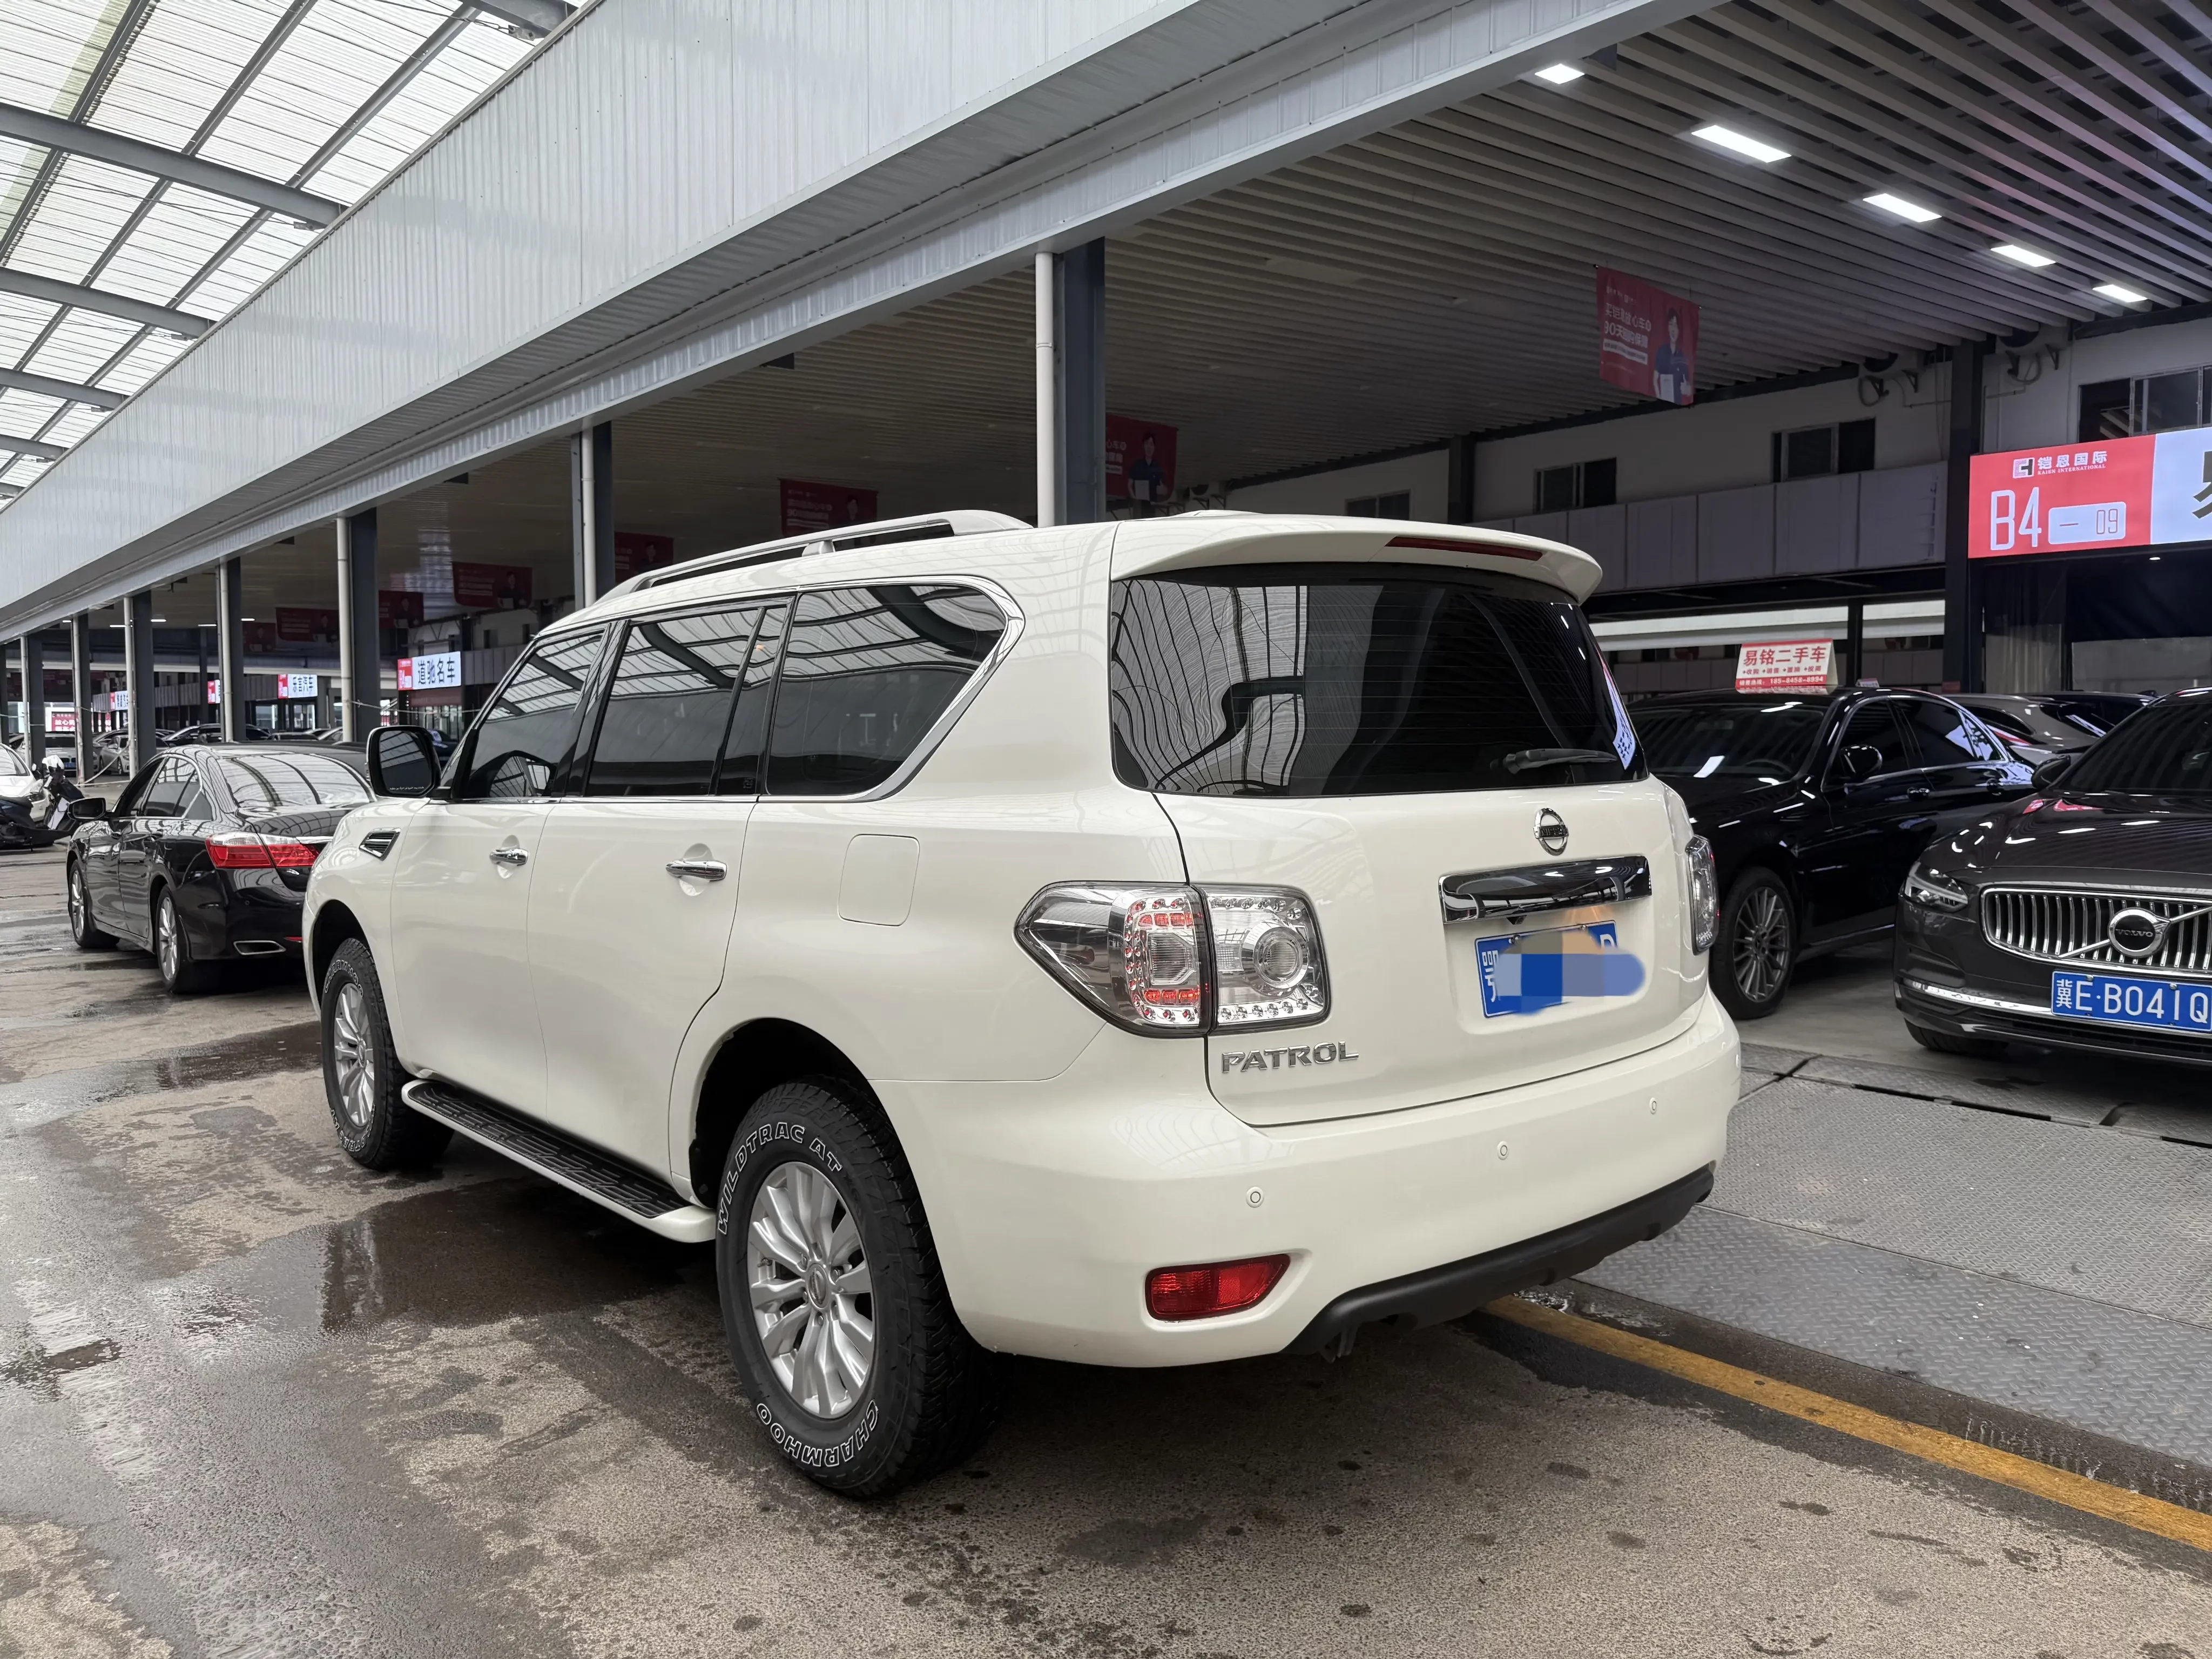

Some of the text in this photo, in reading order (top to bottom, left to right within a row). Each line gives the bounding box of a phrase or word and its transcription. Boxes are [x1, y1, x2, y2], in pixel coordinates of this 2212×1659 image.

[2058, 464, 2106, 473] INTERNATIONAL
[1990, 487, 2042, 550] B4
[419, 657, 455, 684] 道驰名车
[1743, 646, 1826, 666] 易铭二手车
[2115, 928, 2153, 938] VOLVO
[1222, 1040, 1359, 1074] PATROL
[718, 1121, 843, 1236] WILDTRAC AT
[757, 1399, 879, 1468] CHARMHOO
